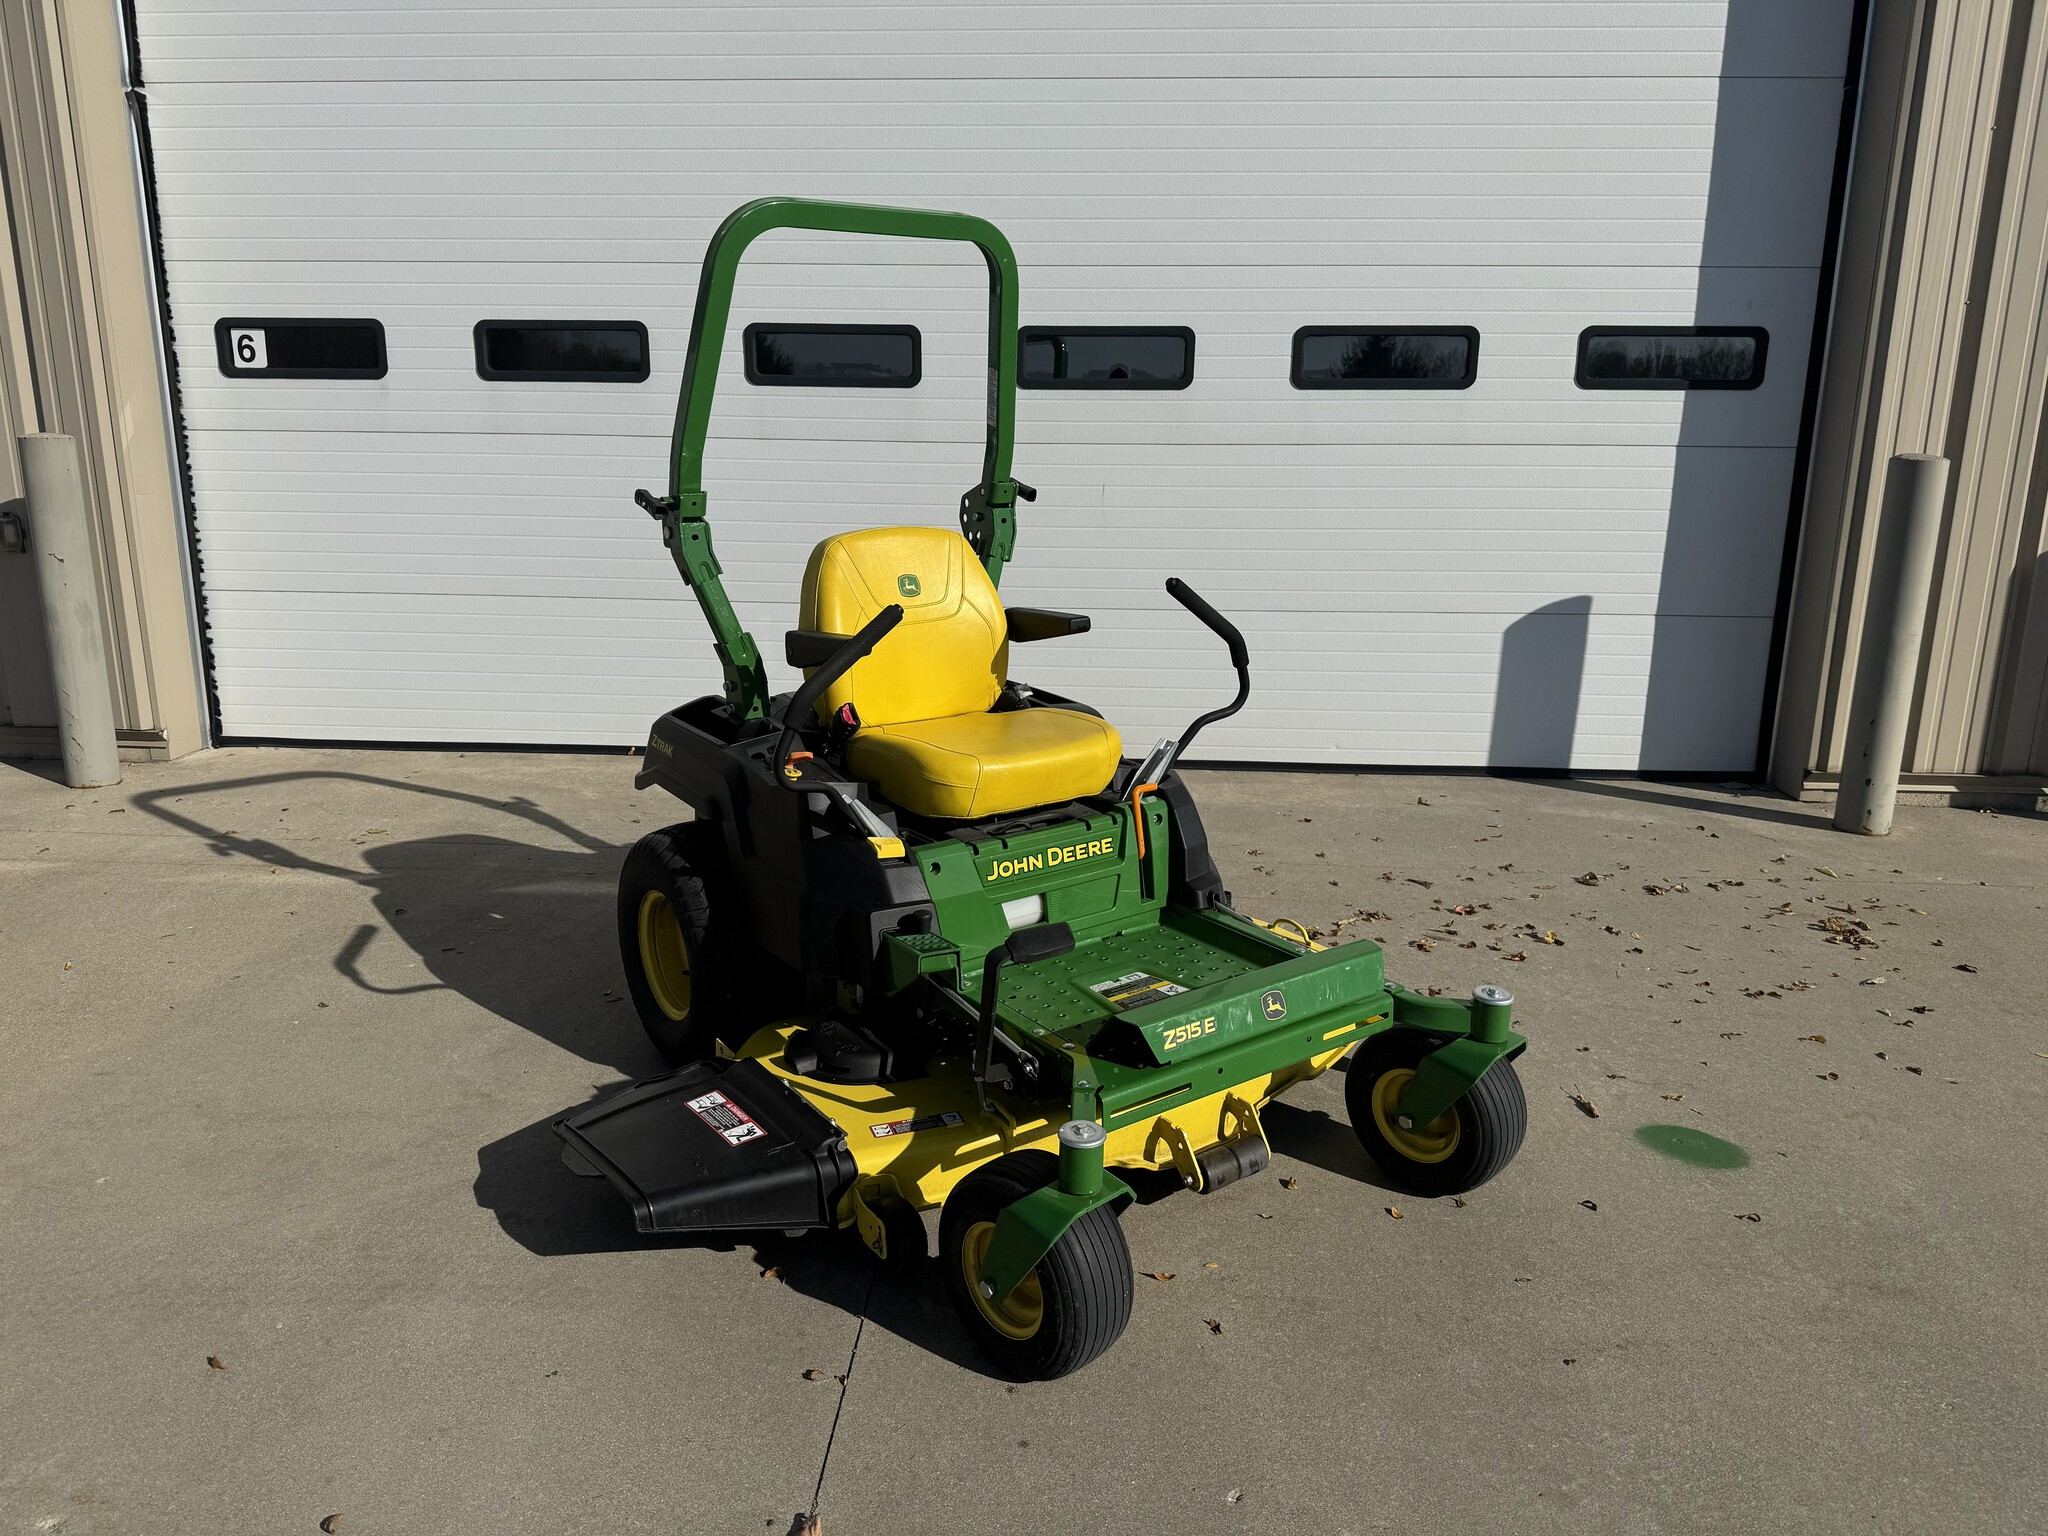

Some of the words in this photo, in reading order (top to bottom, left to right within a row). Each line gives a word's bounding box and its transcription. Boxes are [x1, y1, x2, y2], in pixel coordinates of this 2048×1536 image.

[237, 334, 256, 363] 6
[987, 853, 1043, 881] JOHN
[1046, 837, 1114, 867] DEERE
[1163, 1021, 1202, 1050] Z515
[1204, 1016, 1216, 1034] E
